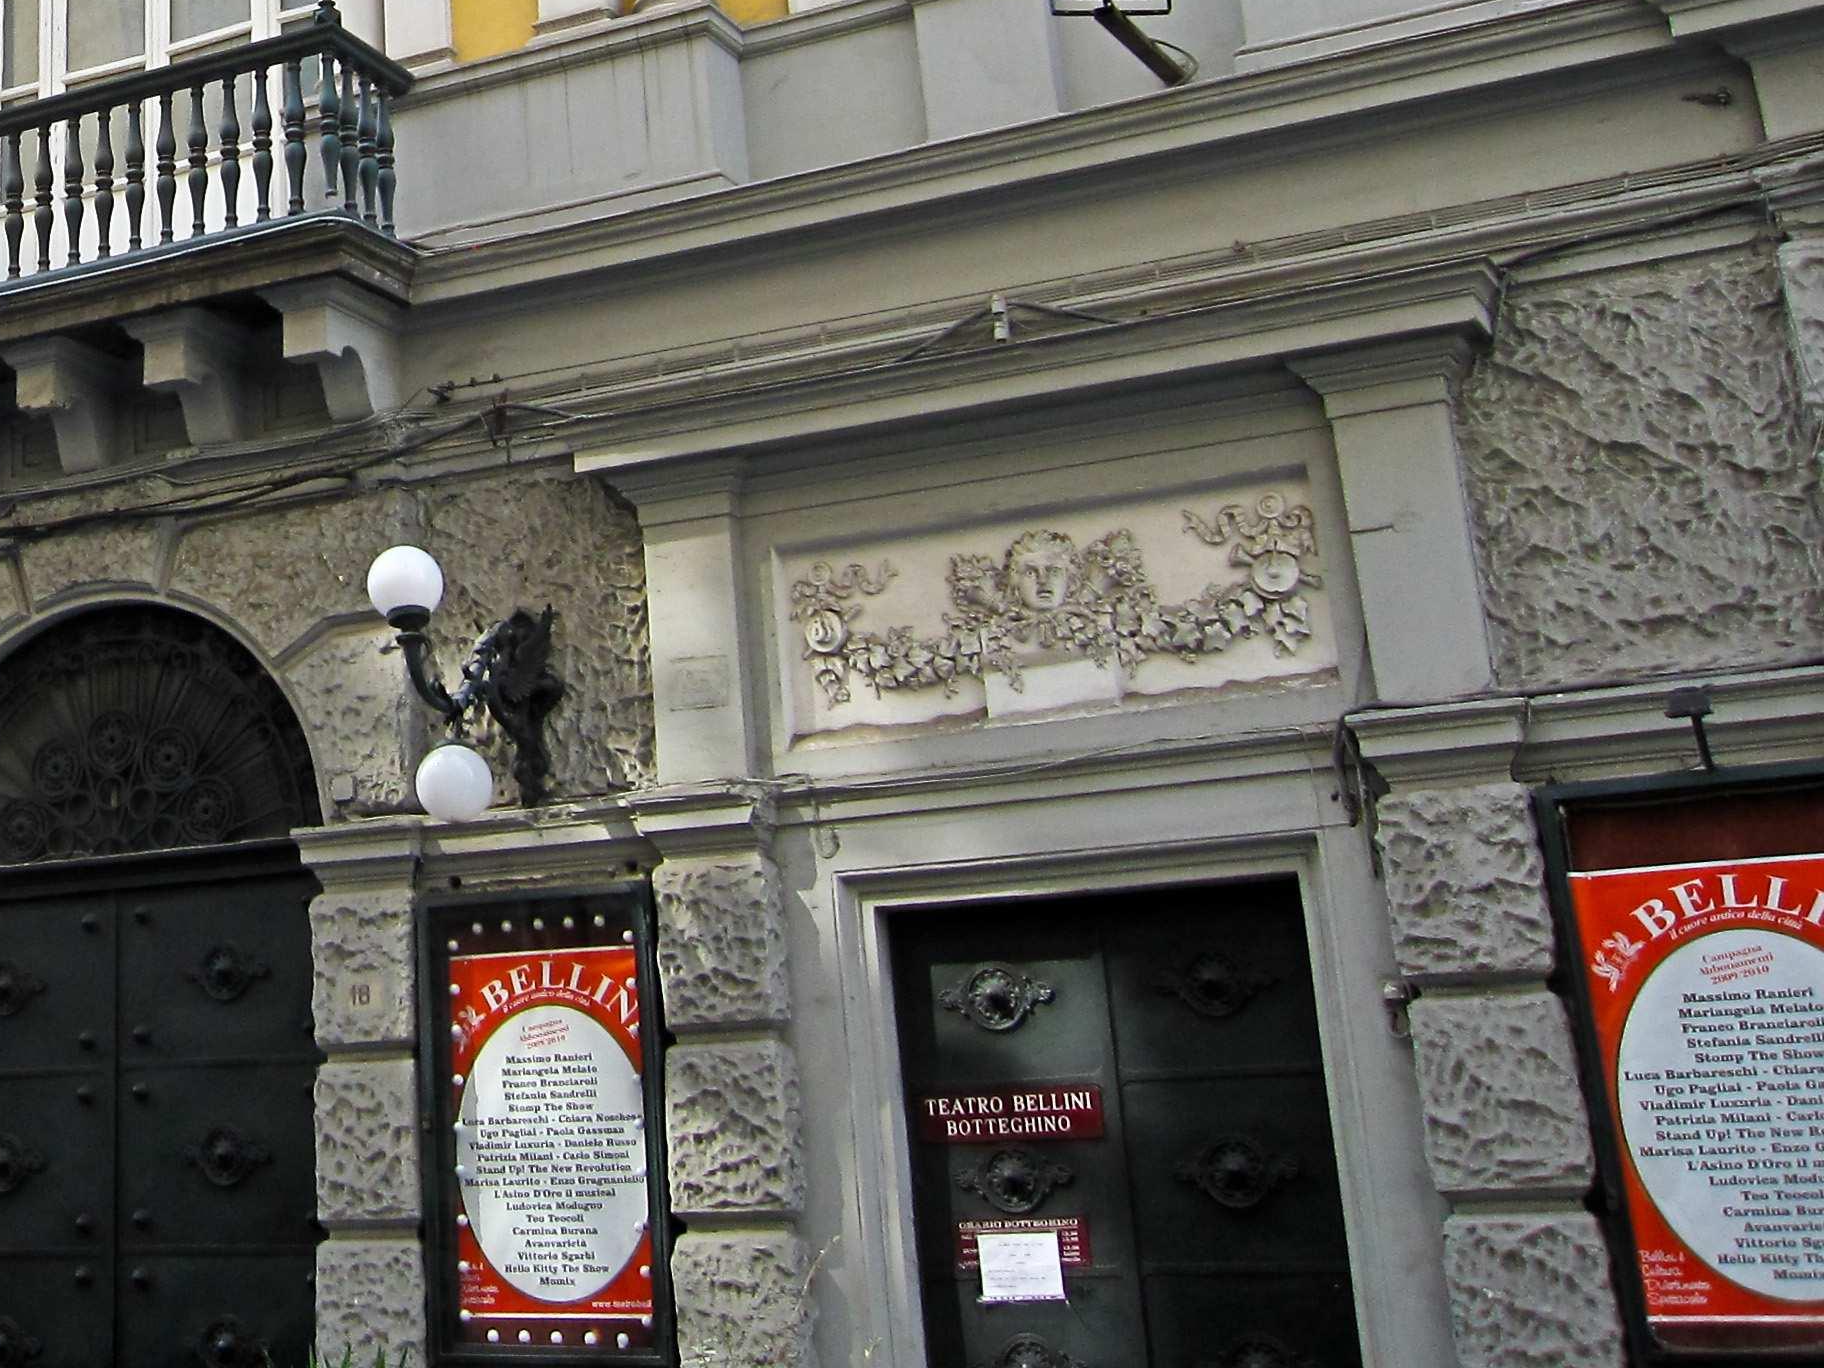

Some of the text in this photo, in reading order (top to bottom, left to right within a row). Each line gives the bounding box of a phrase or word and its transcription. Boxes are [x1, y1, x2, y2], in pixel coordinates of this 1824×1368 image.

[1682, 986, 1814, 1004] Massimo Ranieri
[1678, 1002, 1824, 1019] Mariangela Melato
[1681, 1022, 1734, 1033] Franco
[1687, 1035, 1752, 1049] Stefania
[505, 1052, 593, 1065] Massimo Ranieri
[1694, 1052, 1744, 1064] Stomp
[1747, 1049, 1778, 1061] The
[501, 1065, 598, 1078] Mariangela Melato
[1624, 1070, 1661, 1081] Luca
[1665, 1065, 1758, 1079] Barbareschi
[502, 1077, 598, 1089] Franco Branciaroli
[1654, 1084, 1685, 1097] Ugo
[1689, 1082, 1742, 1097] Pagliai
[1756, 1080, 1801, 1091] Paola
[504, 1089, 598, 1102] Stefania Sandrelli
[544, 1103, 564, 1112] The
[566, 1101, 594, 1111] Show
[925, 1091, 1092, 1116] TEATRO BELLINI
[1639, 1099, 1706, 1111] Vladimir
[1710, 1096, 1772, 1108] Luxuria
[946, 1114, 1072, 1137] BOTTEGHINO
[1655, 1114, 1717, 1126] Patrizia
[1720, 1112, 1771, 1124] Milani
[546, 1127, 576, 1137] Paola
[1655, 1130, 1702, 1142] Stand
[1706, 1128, 1732, 1141] Up!
[1736, 1128, 1765, 1139] The
[1769, 1127, 1805, 1138] New
[1639, 1146, 1694, 1157] Marisa
[1698, 1143, 1757, 1156] Laurito
[1771, 1142, 1811, 1153] Enzo
[476, 1165, 506, 1175] Stand
[528, 1164, 548, 1174] The
[551, 1163, 573, 1173] New
[575, 1161, 632, 1173] Revolution
[550, 1176, 577, 1186] Enzo
[1708, 1174, 1778, 1186] Ludovica
[1740, 1190, 1770, 1202] Teo
[1722, 1205, 1792, 1217] Carmina
[512, 1225, 599, 1236] Carmina Burana
[1734, 1236, 1797, 1249] Vittorio
[1717, 1253, 1756, 1265] Hello
[1760, 1252, 1800, 1266] Kitty
[533, 1263, 558, 1275] Kitty
